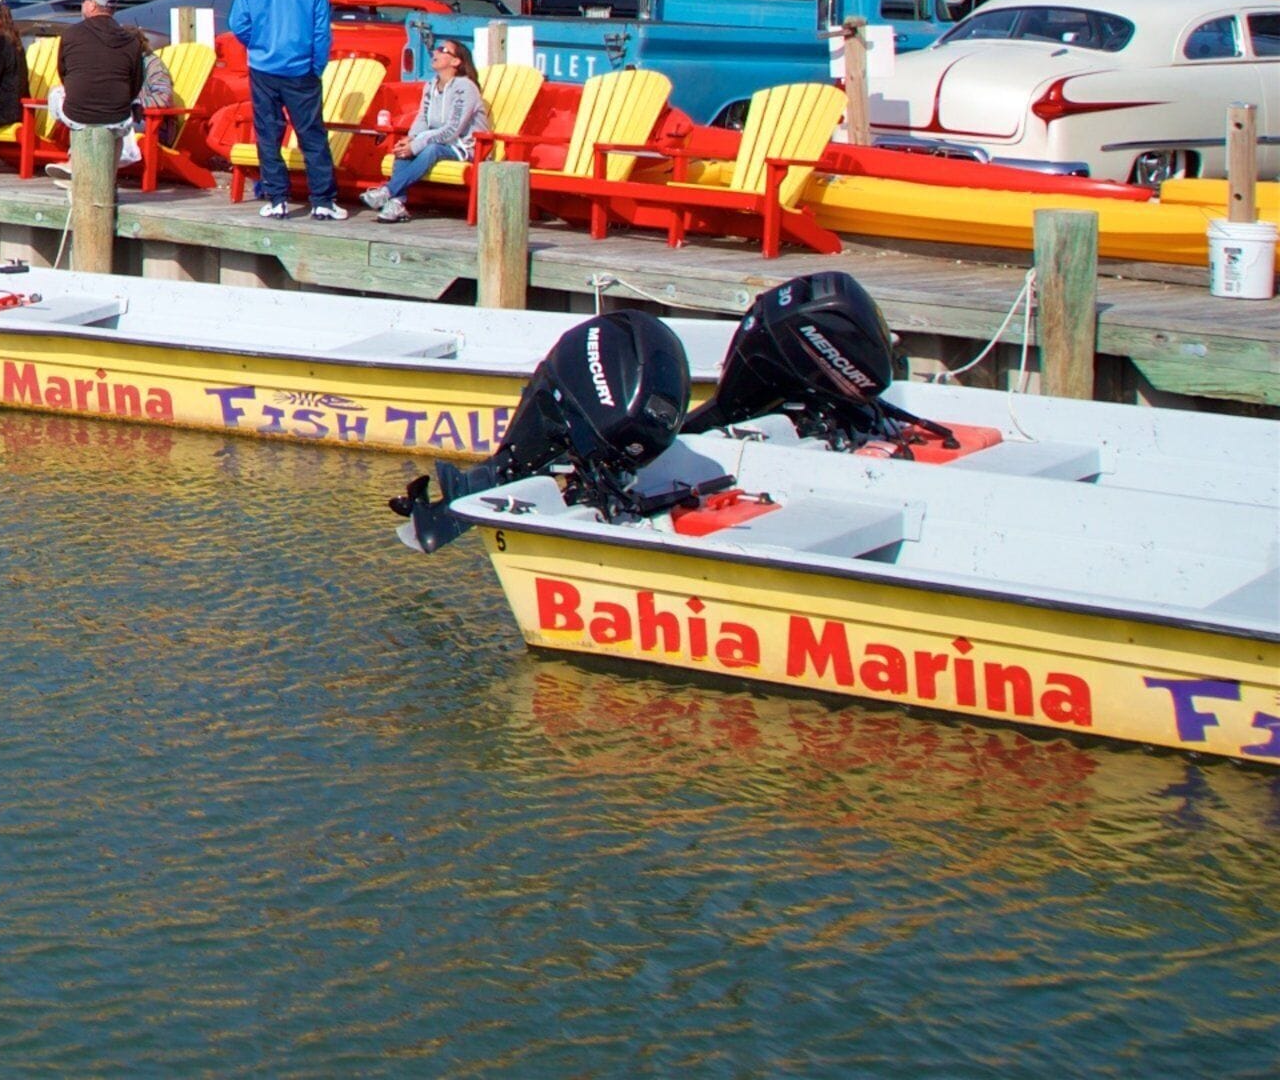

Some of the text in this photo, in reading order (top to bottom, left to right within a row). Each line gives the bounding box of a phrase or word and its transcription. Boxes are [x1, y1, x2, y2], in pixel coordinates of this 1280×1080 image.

[778, 285, 792, 307] 30
[586, 327, 615, 407] MERCURY
[799, 324, 878, 390] MERCURY
[2, 361, 175, 421] Marina
[204, 385, 510, 453] FISH TALE
[535, 576, 1093, 727] Bahia Marina
